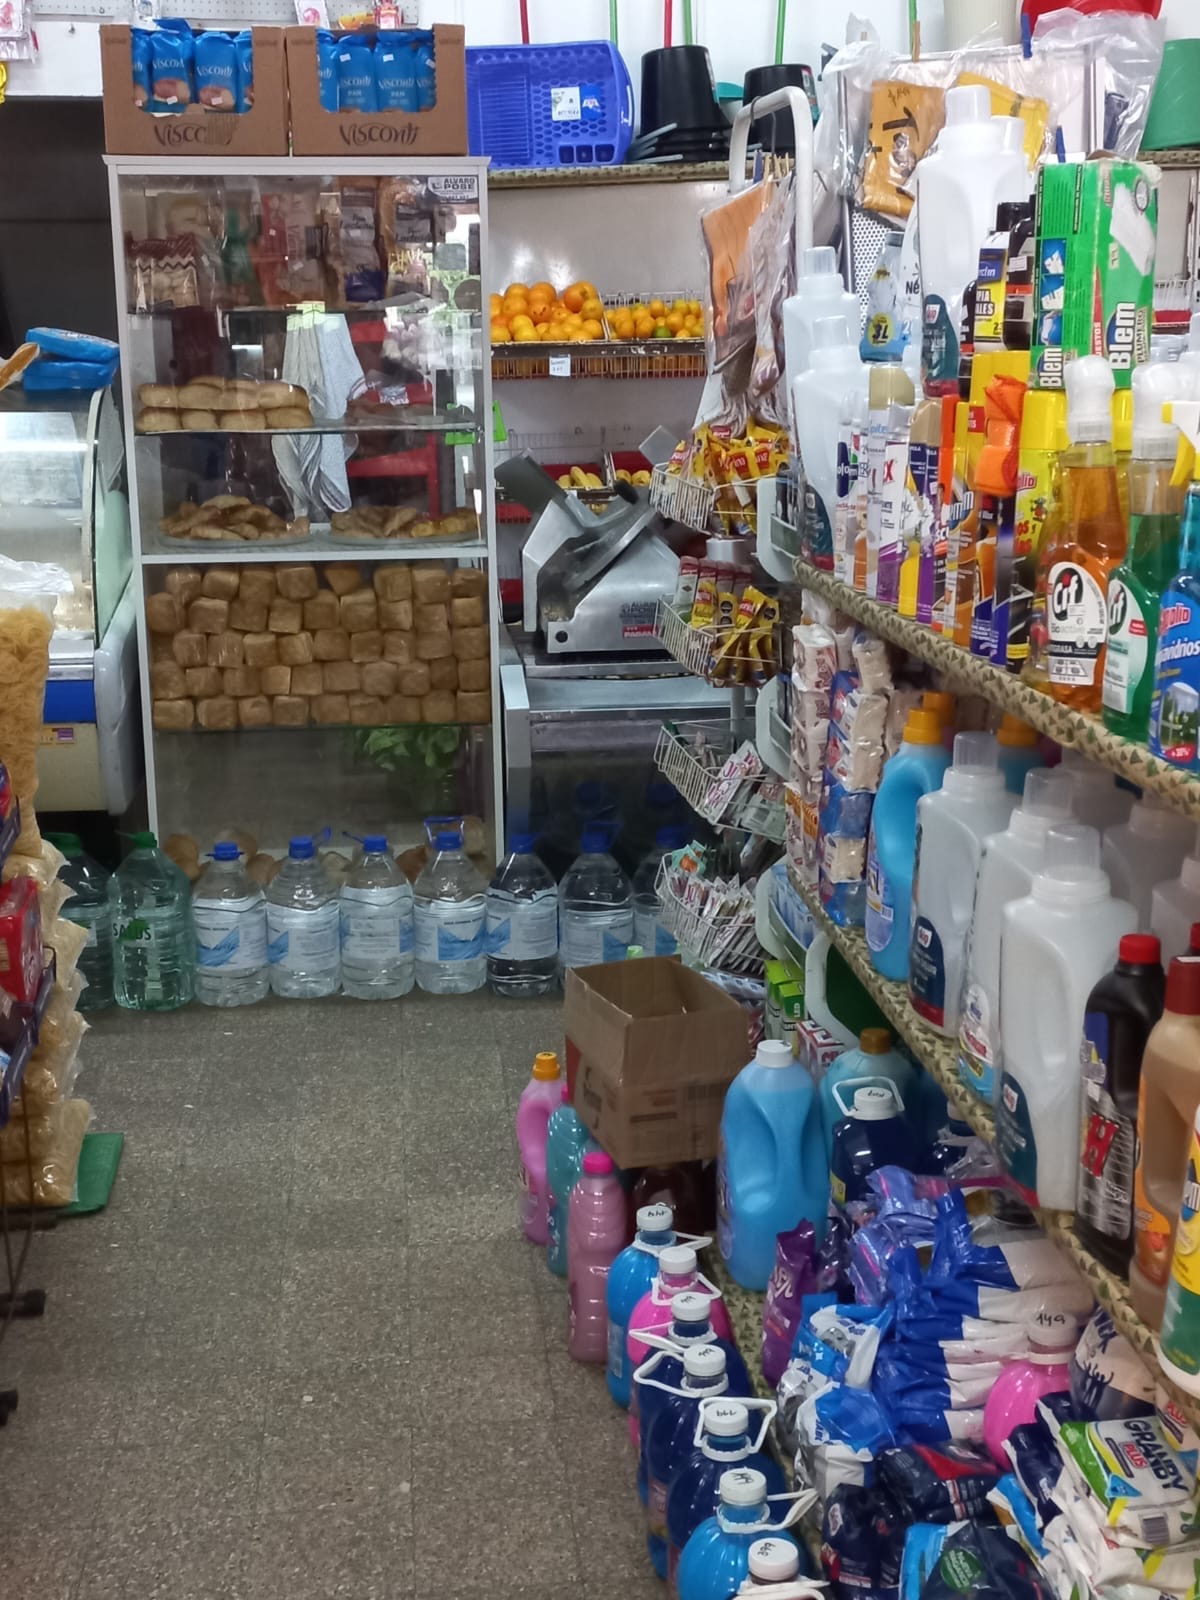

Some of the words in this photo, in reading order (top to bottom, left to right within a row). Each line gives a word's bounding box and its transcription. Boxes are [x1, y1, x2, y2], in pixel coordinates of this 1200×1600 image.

[339, 122, 420, 146] Visconti
[443, 175, 476, 184] ALVARO
[1108, 302, 1136, 370] Blem
[1137, 310, 1145, 364] PLUMERO
[1040, 348, 1062, 387] Blem
[1054, 574, 1078, 614] cif
[1123, 1442, 1147, 1468] PLUS
[1123, 1420, 1190, 1492] GRANBY
